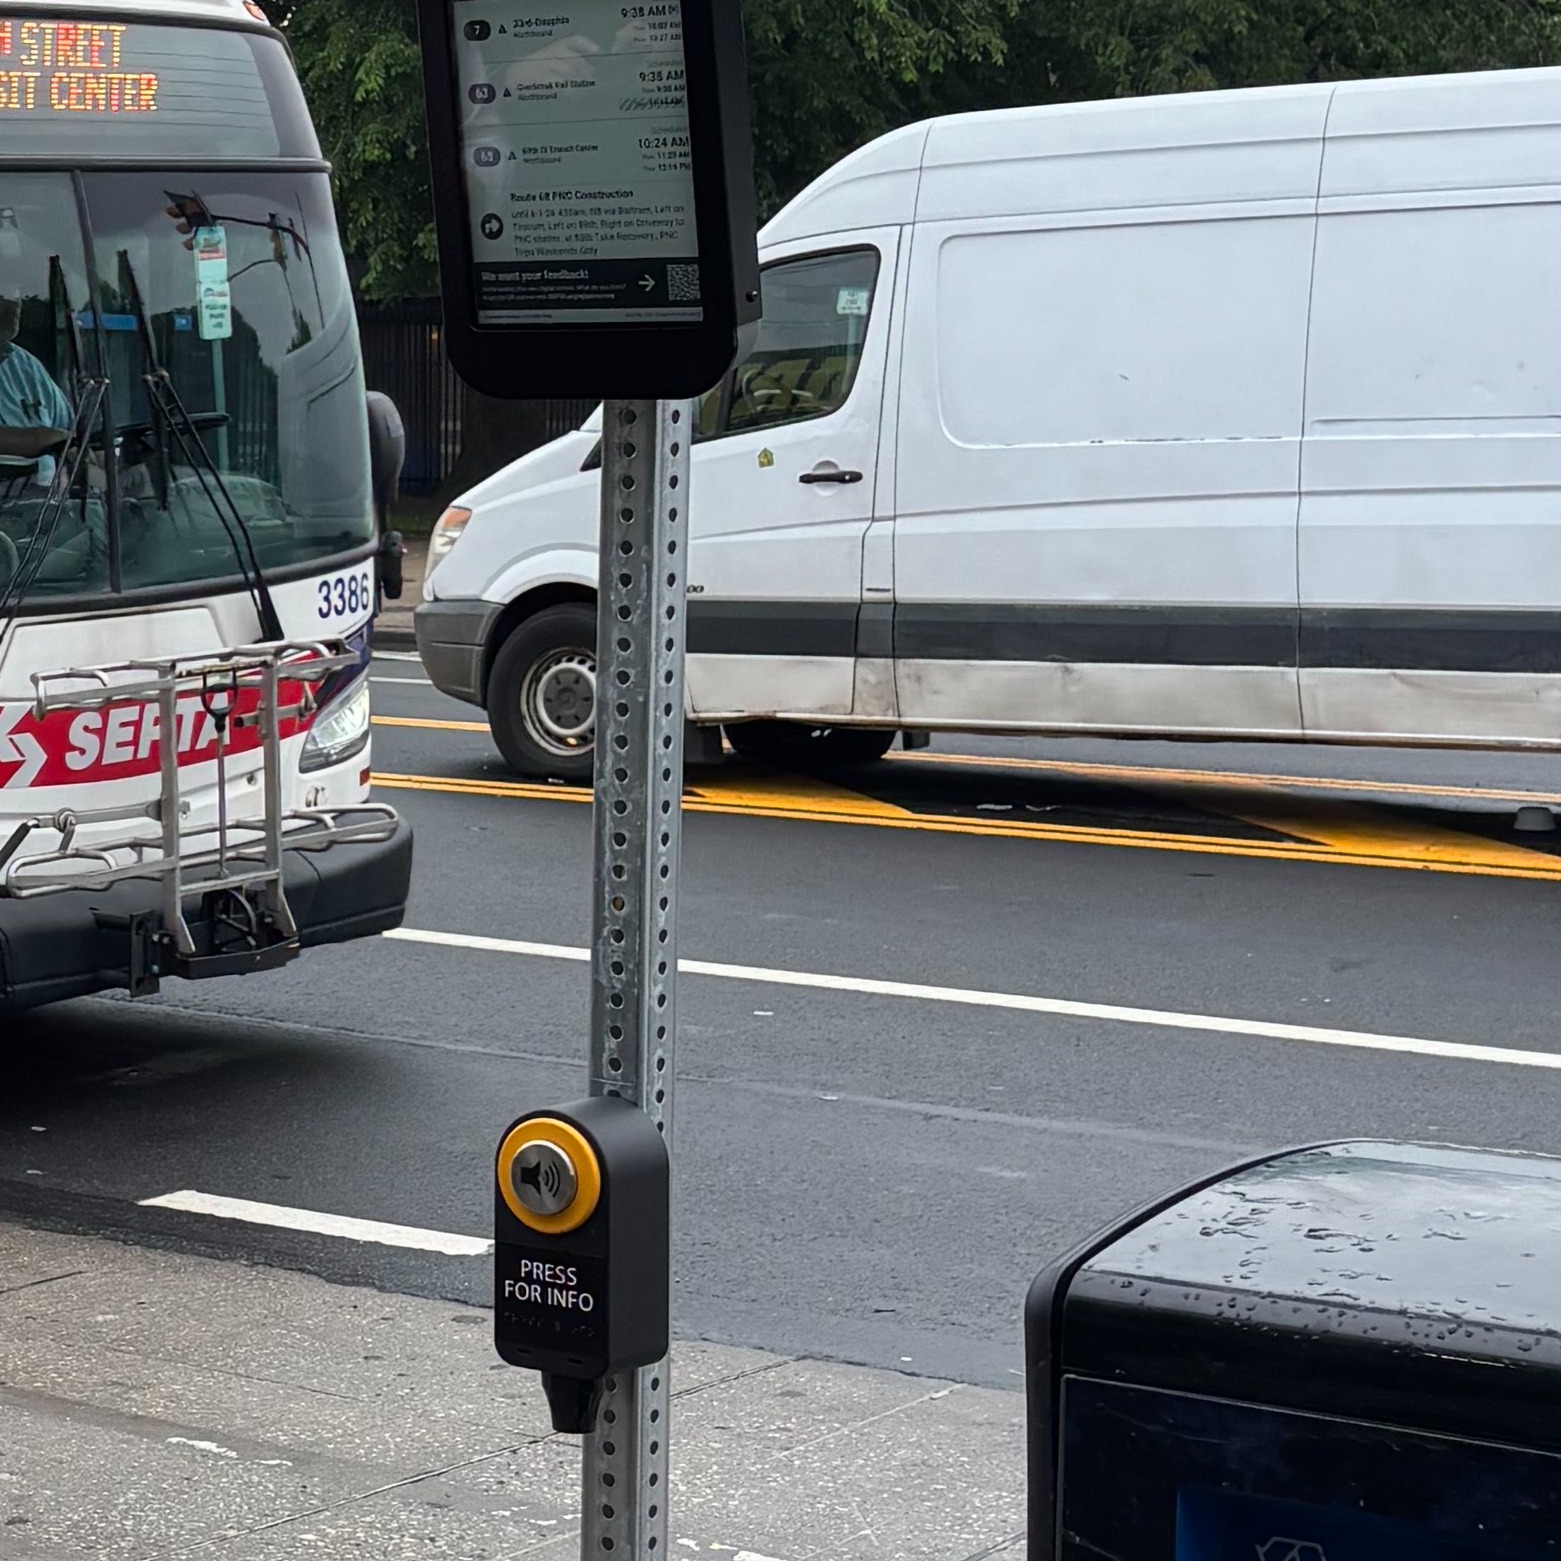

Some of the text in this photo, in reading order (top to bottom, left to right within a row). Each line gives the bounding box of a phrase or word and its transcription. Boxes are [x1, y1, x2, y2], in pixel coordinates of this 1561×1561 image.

[20, 21, 127, 68] STREET
[50, 72, 159, 112] CENTER
[638, 137, 668, 149] 10:24
[574, 190, 634, 200] Construction
[318, 572, 370, 619] 3386
[521, 1259, 577, 1286] PRESS
[505, 1279, 594, 1312] FOR INFO
